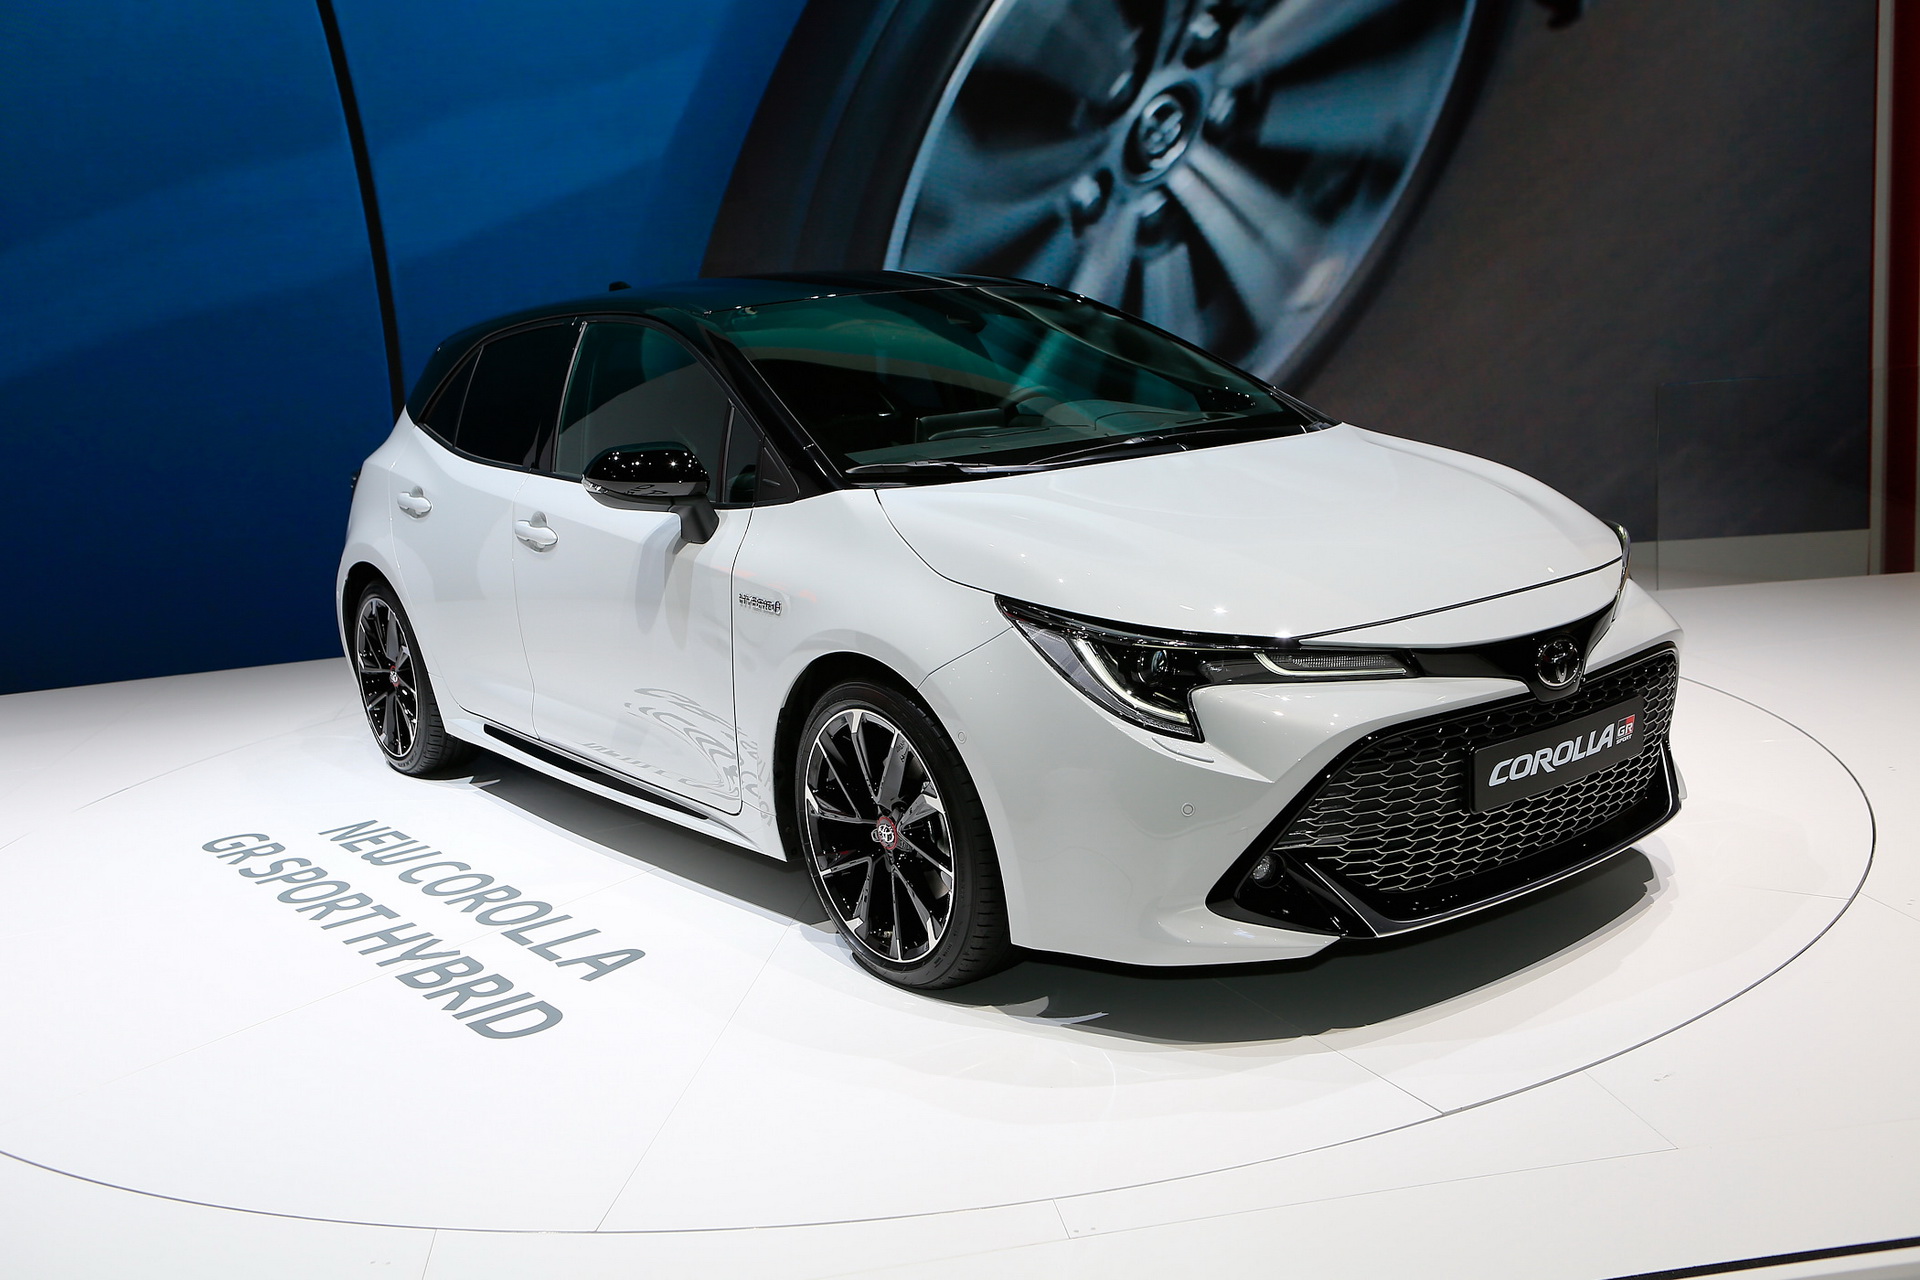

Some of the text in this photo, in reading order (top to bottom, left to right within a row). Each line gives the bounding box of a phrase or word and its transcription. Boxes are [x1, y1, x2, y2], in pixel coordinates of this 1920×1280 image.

[1488, 722, 1634, 787] COROLLA GR
[1615, 734, 1633, 745] SPORT
[202, 833, 563, 1040] GR SPORT HYBRID
[318, 820, 646, 982] NEW COROLLA
